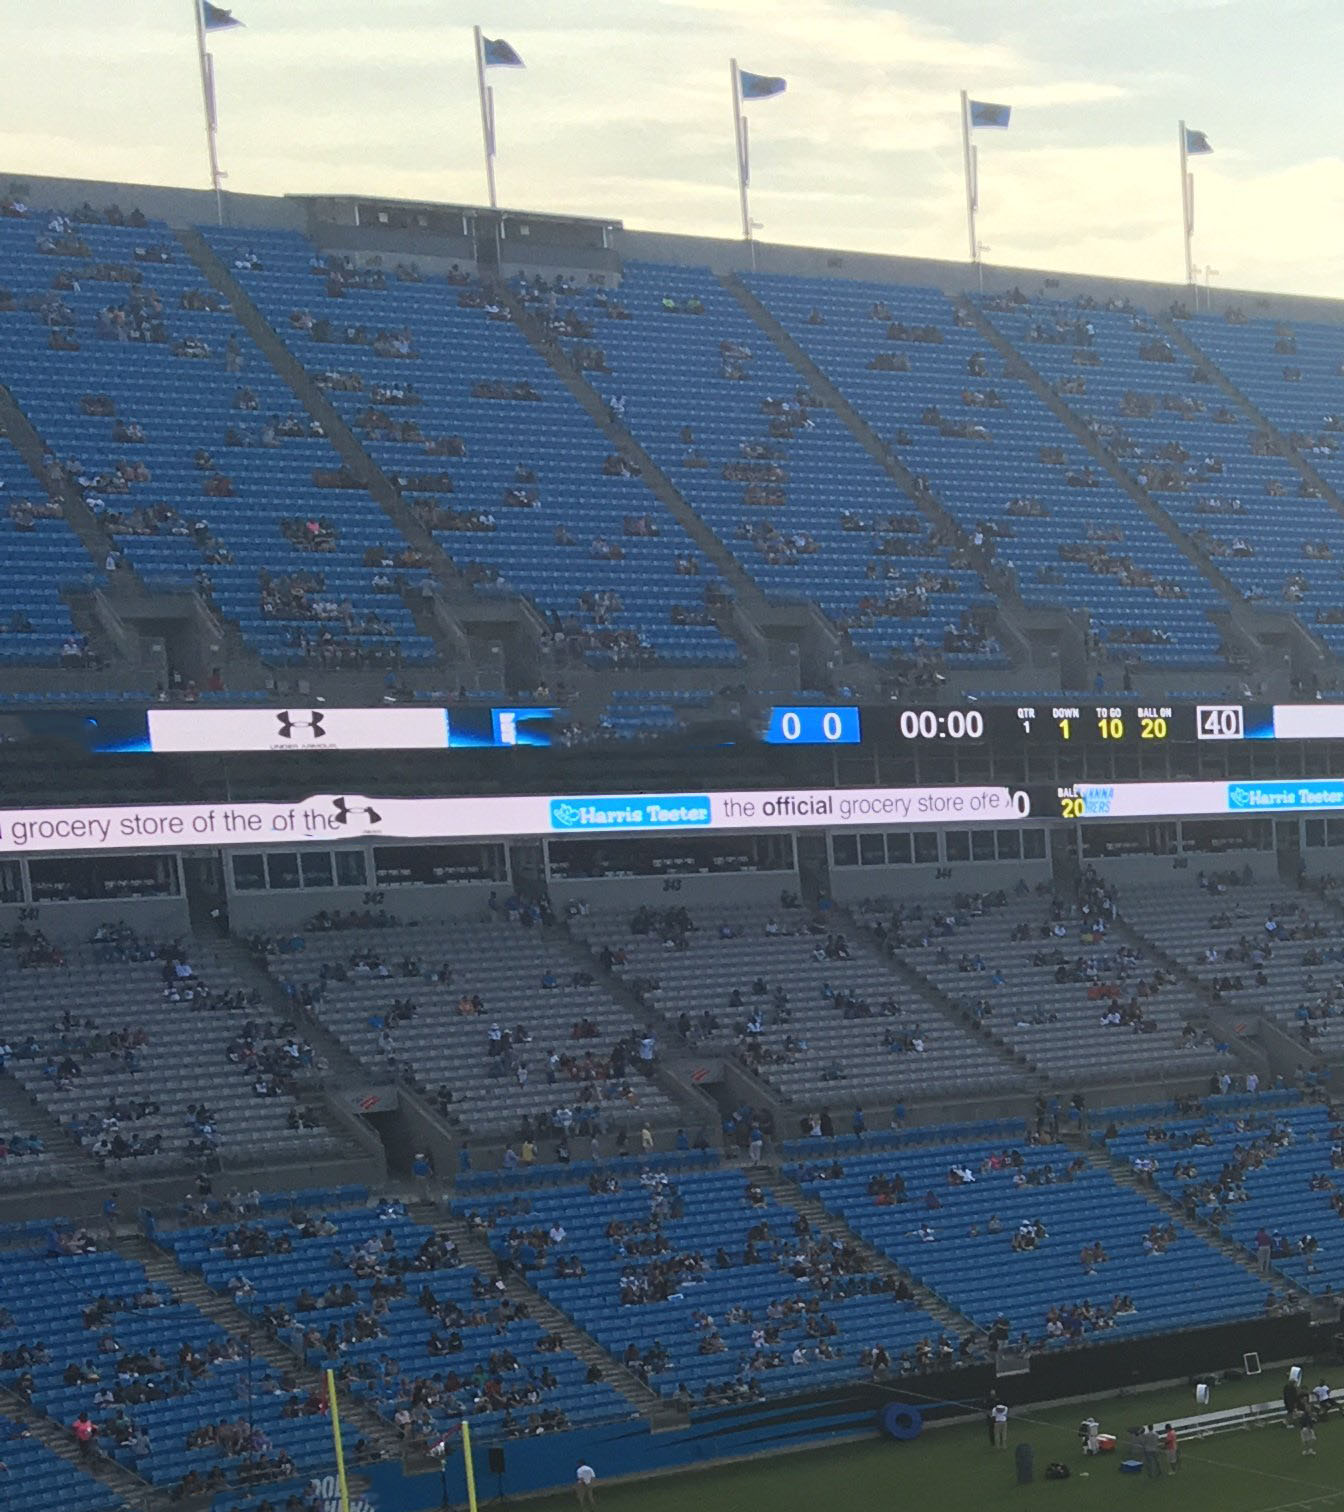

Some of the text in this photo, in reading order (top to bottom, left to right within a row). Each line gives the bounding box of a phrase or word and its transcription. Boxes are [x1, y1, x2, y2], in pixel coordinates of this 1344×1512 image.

[1017, 708, 1035, 718] QTR
[1053, 708, 1079, 718] DOWN
[1096, 708, 1122, 718] TO GO
[1137, 708, 1172, 718] BALL ON
[1205, 710, 1237, 735] 40
[782, 712, 842, 740] 0 0
[900, 710, 984, 738] 00:00
[1023, 721, 1030, 733] 1
[1059, 719, 1070, 739] 1
[1098, 718, 1123, 739] 10
[1141, 718, 1167, 739] 20
[1249, 790, 1295, 805] Harris
[1298, 788, 1344, 803] Teeter
[578, 793, 964, 825] Harris Teeter the official grocery store
[1061, 799, 1086, 818] 20
[11, 818, 111, 845] grocery
[121, 814, 184, 835] store
[193, 810, 216, 833] of
[223, 810, 262, 832] the
[272, 809, 295, 832] of
